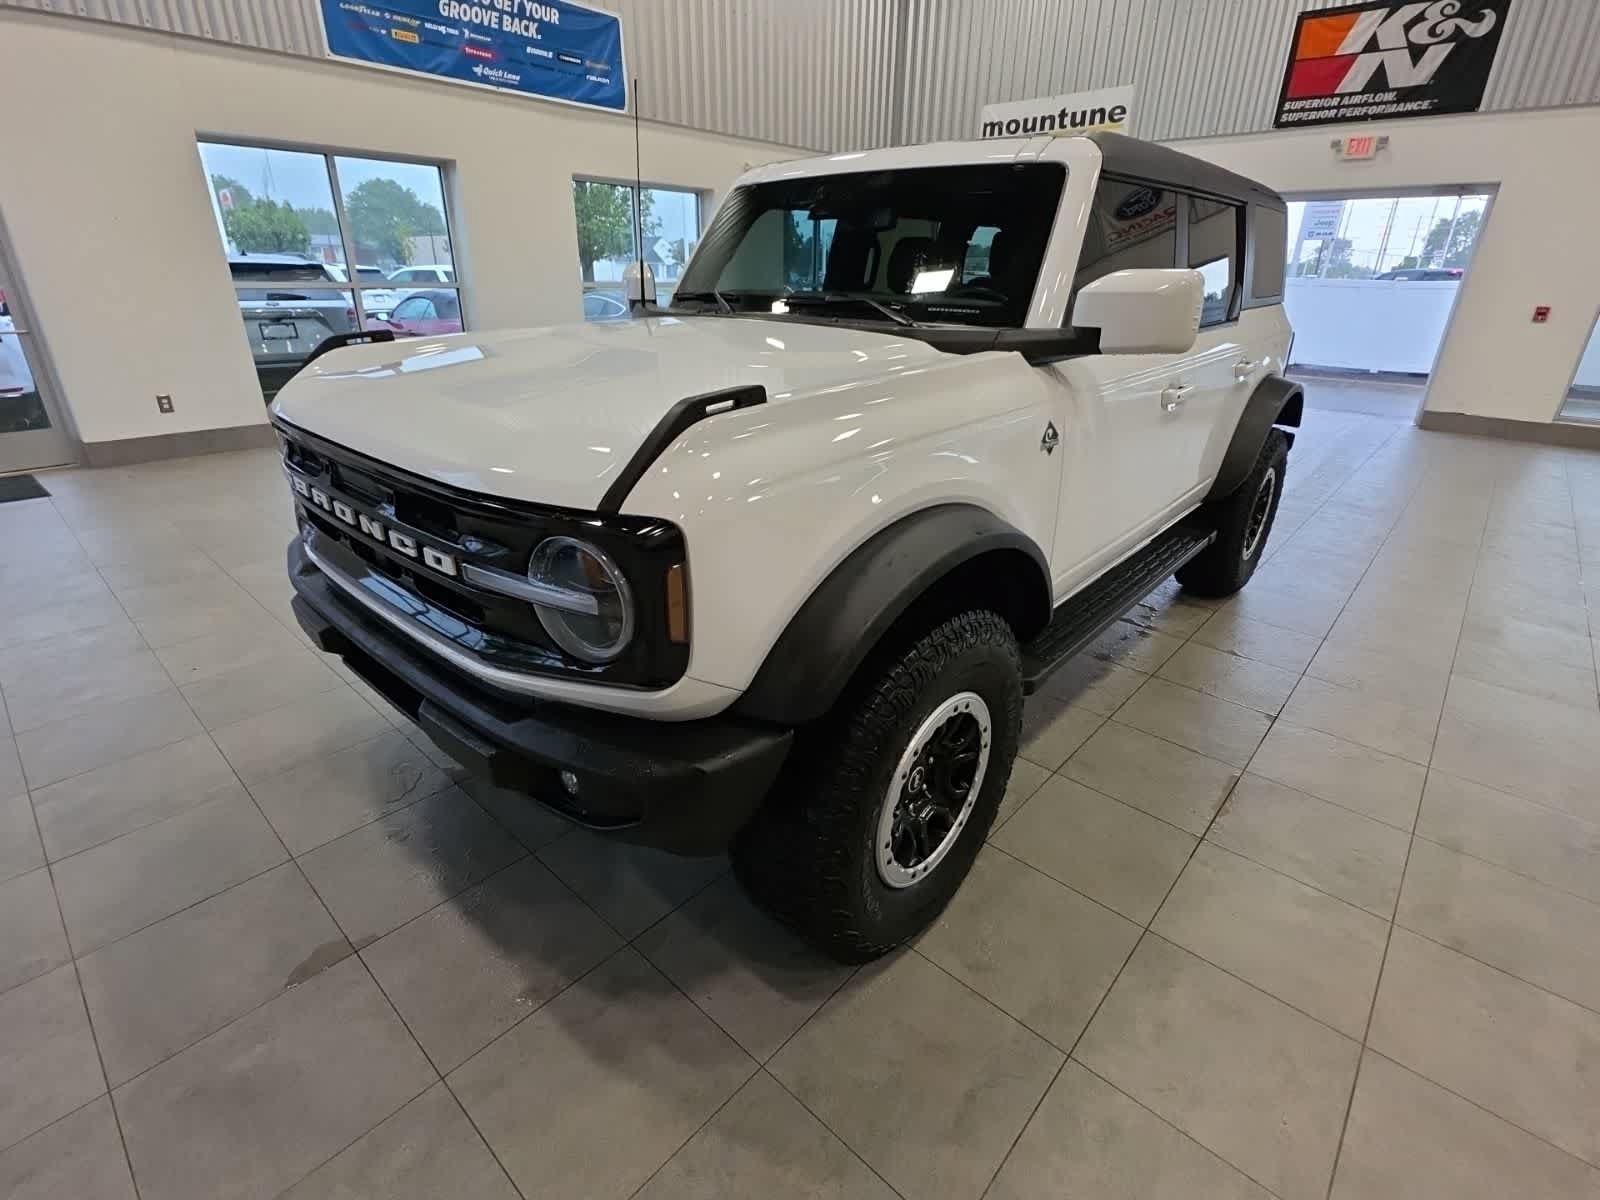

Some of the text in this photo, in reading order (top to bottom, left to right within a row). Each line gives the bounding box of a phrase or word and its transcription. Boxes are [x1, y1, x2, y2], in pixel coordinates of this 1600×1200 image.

[439, 0, 500, 29] GROOVE
[502, 14, 542, 40] BACK.
[493, 0, 560, 24] GET YOUR
[482, 65, 503, 78] Quick
[1283, 96, 1341, 111] SUPERIOR
[982, 104, 1127, 138] mountune
[1280, 108, 1338, 122] SUPERIOR
[1346, 136, 1375, 155] EXIT
[292, 474, 458, 577] BRONCO
